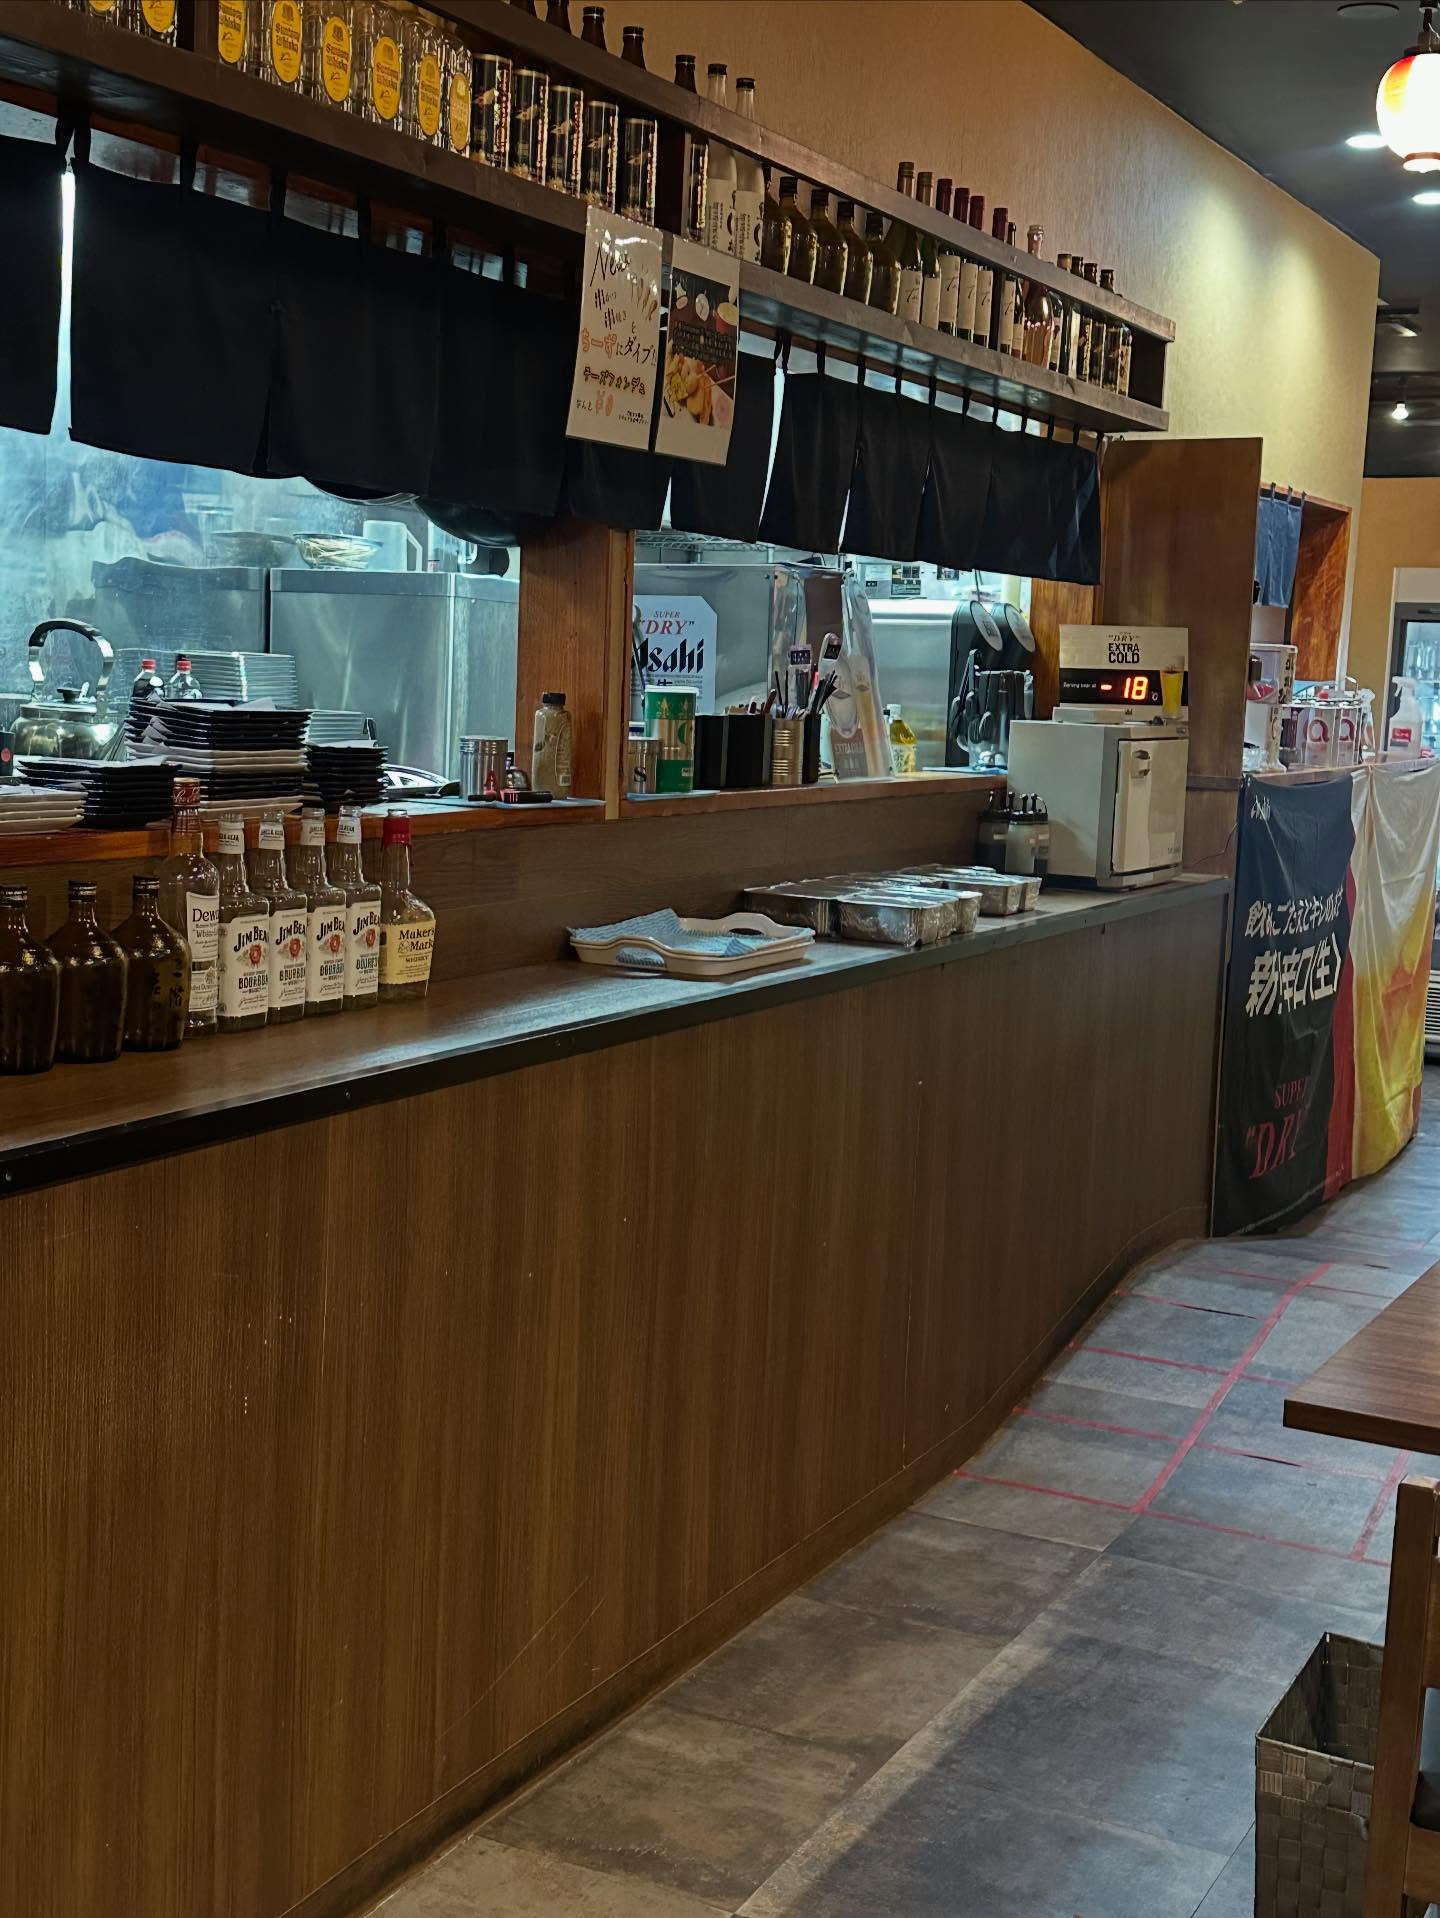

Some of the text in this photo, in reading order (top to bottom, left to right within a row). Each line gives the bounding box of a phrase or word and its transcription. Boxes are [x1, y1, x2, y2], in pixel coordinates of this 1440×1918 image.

[1107, 642, 1140, 653] EXTRA
[1108, 651, 1140, 664] COLD
[275, 924, 293, 946] JIM
[316, 920, 333, 941] JIM
[352, 914, 370, 936] JIM
[233, 930, 252, 953] JIM
